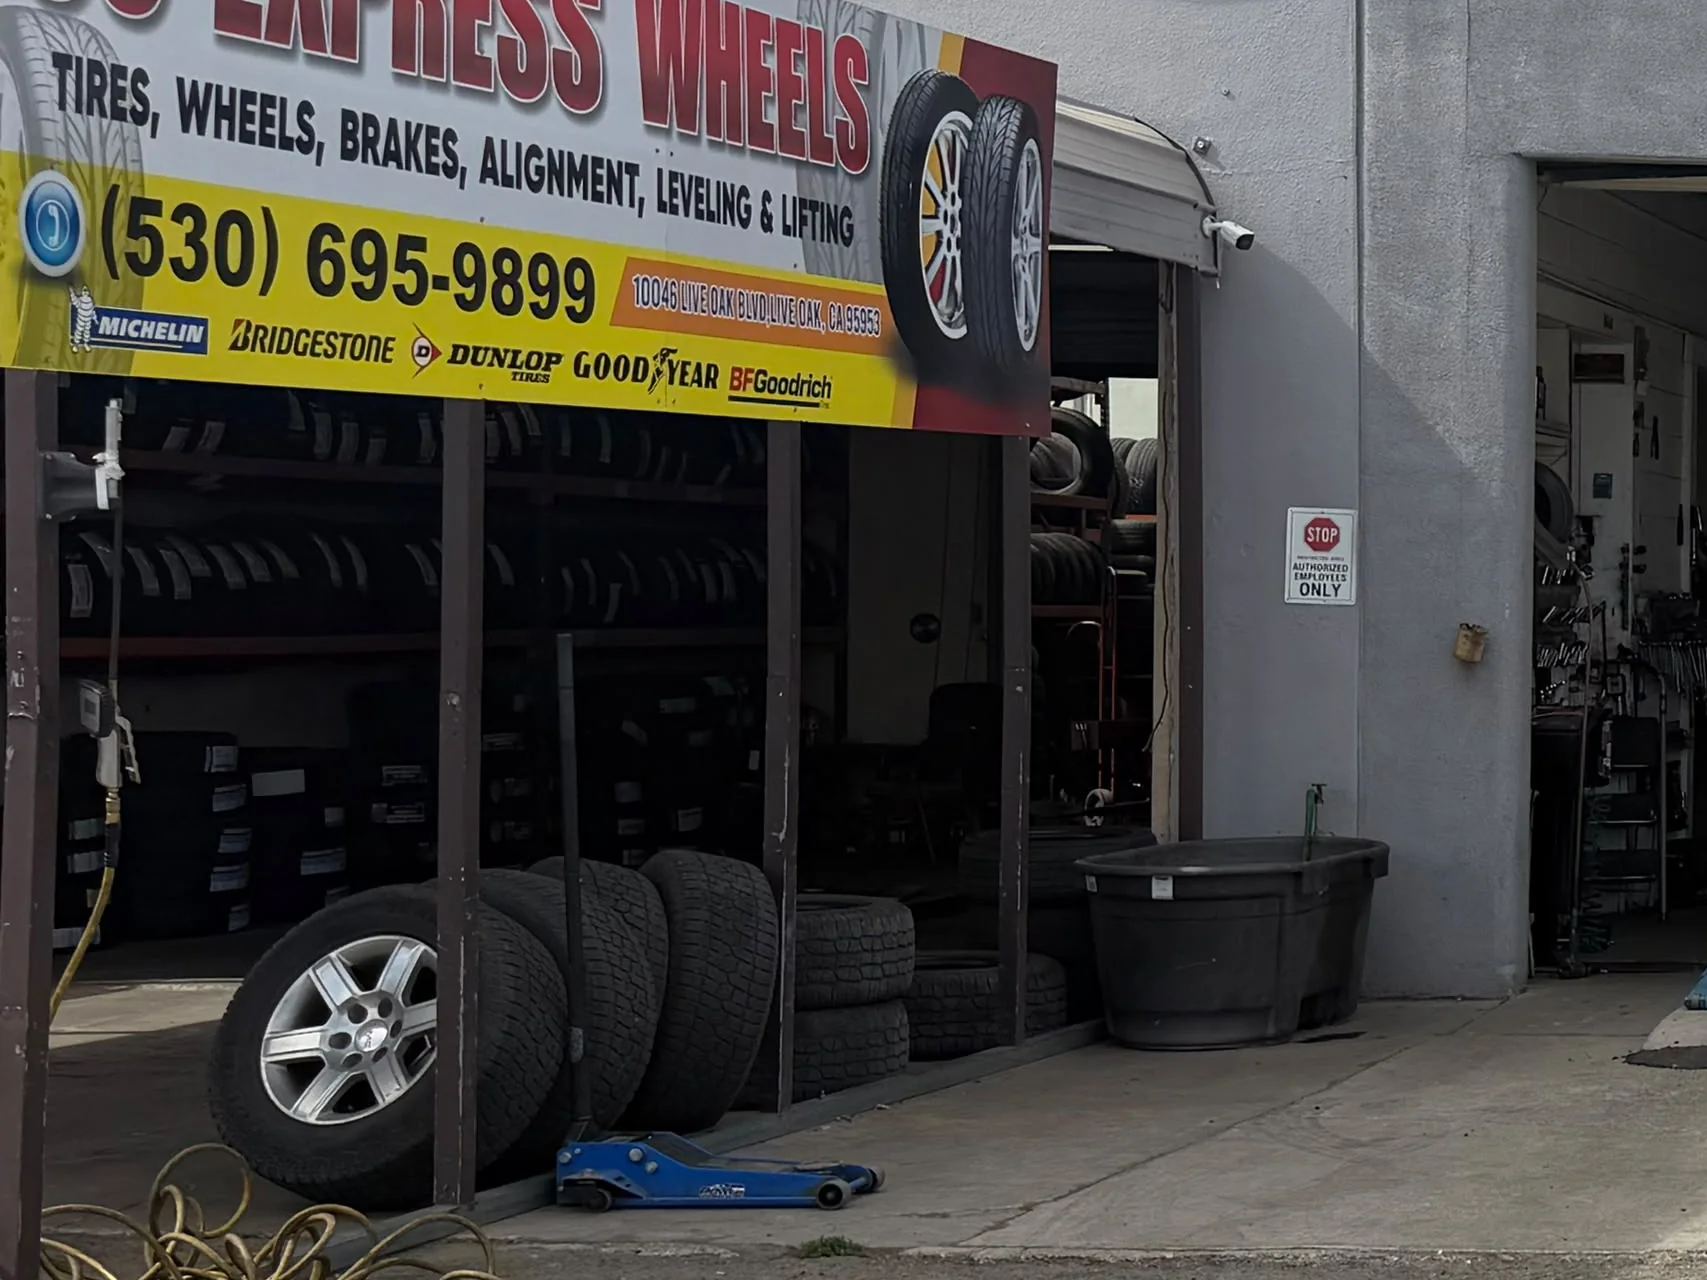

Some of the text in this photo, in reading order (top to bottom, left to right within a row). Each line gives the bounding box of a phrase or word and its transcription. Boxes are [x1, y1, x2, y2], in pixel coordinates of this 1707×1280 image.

[52, 51, 854, 248] TIRES, WHEELS, BRAKES, ALIGNMENT, LEVELING & LIFTING
[101, 184, 596, 324] (530) 695-9899
[632, 273, 678, 312] 10046
[680, 280, 708, 316] LIVE
[710, 283, 735, 320] OAK
[797, 296, 826, 335] OAK,
[828, 301, 844, 333] CA
[845, 304, 882, 337] 95953
[98, 316, 205, 344] MICHELIN
[228, 318, 396, 363] BRIDGESTONE
[447, 344, 564, 372] DUNLOP
[511, 371, 551, 384] TIRES
[729, 365, 832, 399] BFGoodrich
[1306, 527, 1338, 543] STOP
[1293, 562, 1349, 573] AUTHORIZED
[1295, 572, 1347, 582] EMPLOYEES
[1300, 582, 1341, 597] ONLY
